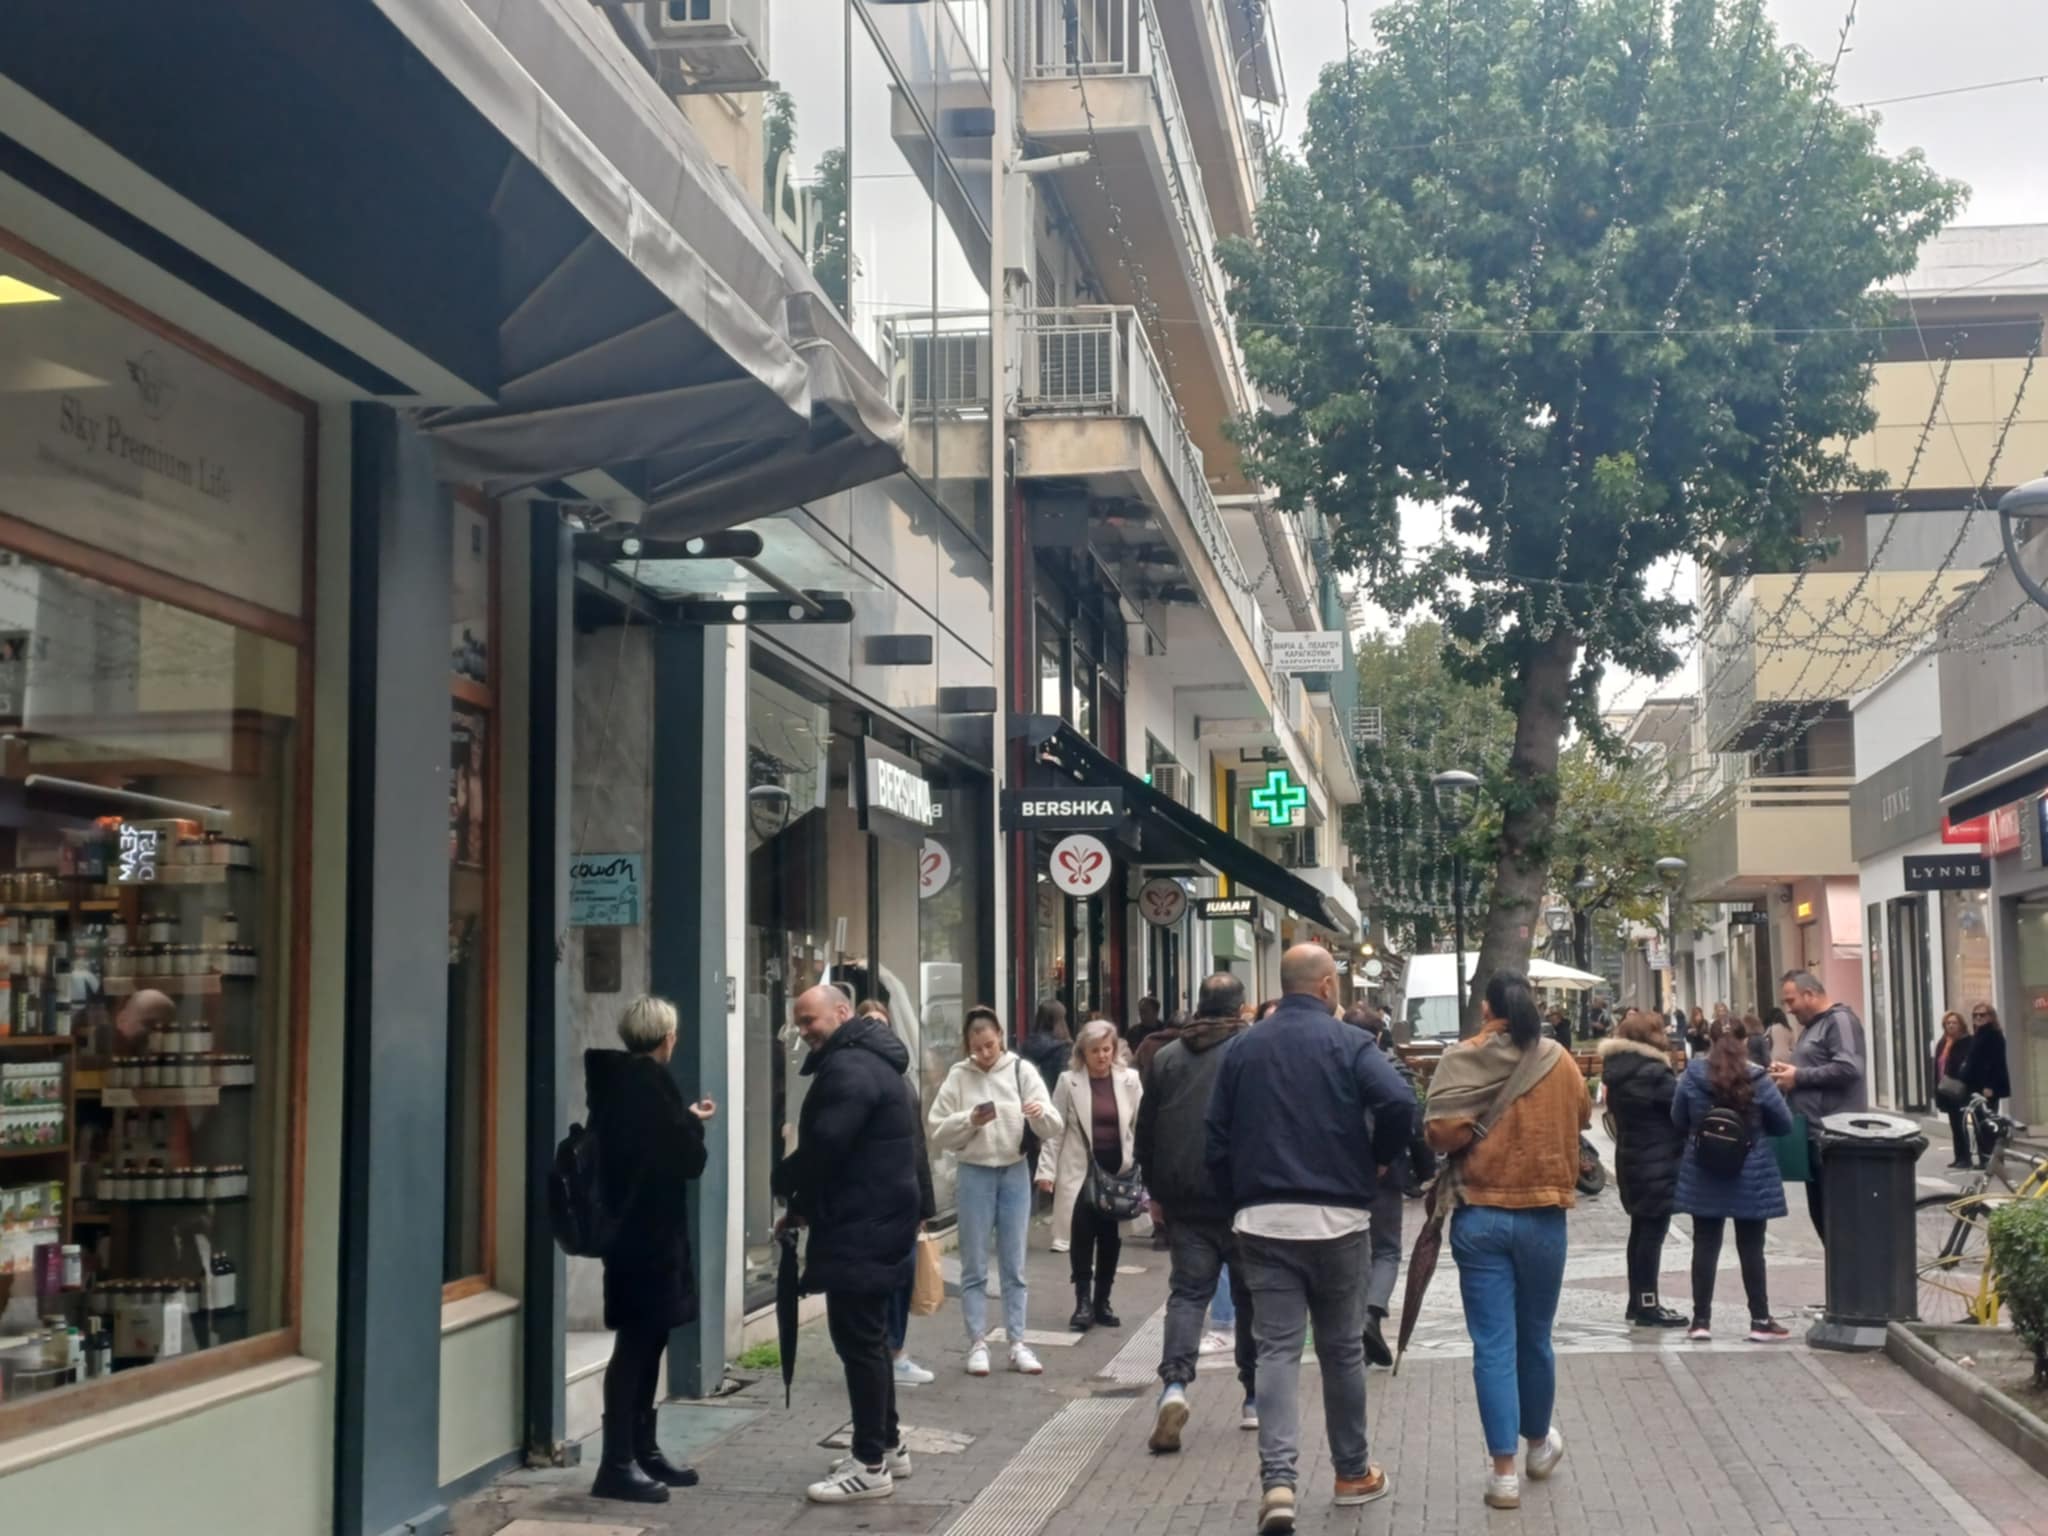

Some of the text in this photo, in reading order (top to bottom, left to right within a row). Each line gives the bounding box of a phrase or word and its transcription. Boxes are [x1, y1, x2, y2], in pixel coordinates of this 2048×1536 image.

[60, 394, 232, 503] Sky Premium Life
[878, 758, 933, 827] BERSHKA
[1022, 799, 1114, 816] BERSHKA
[1911, 864, 1982, 879] LYNNE
